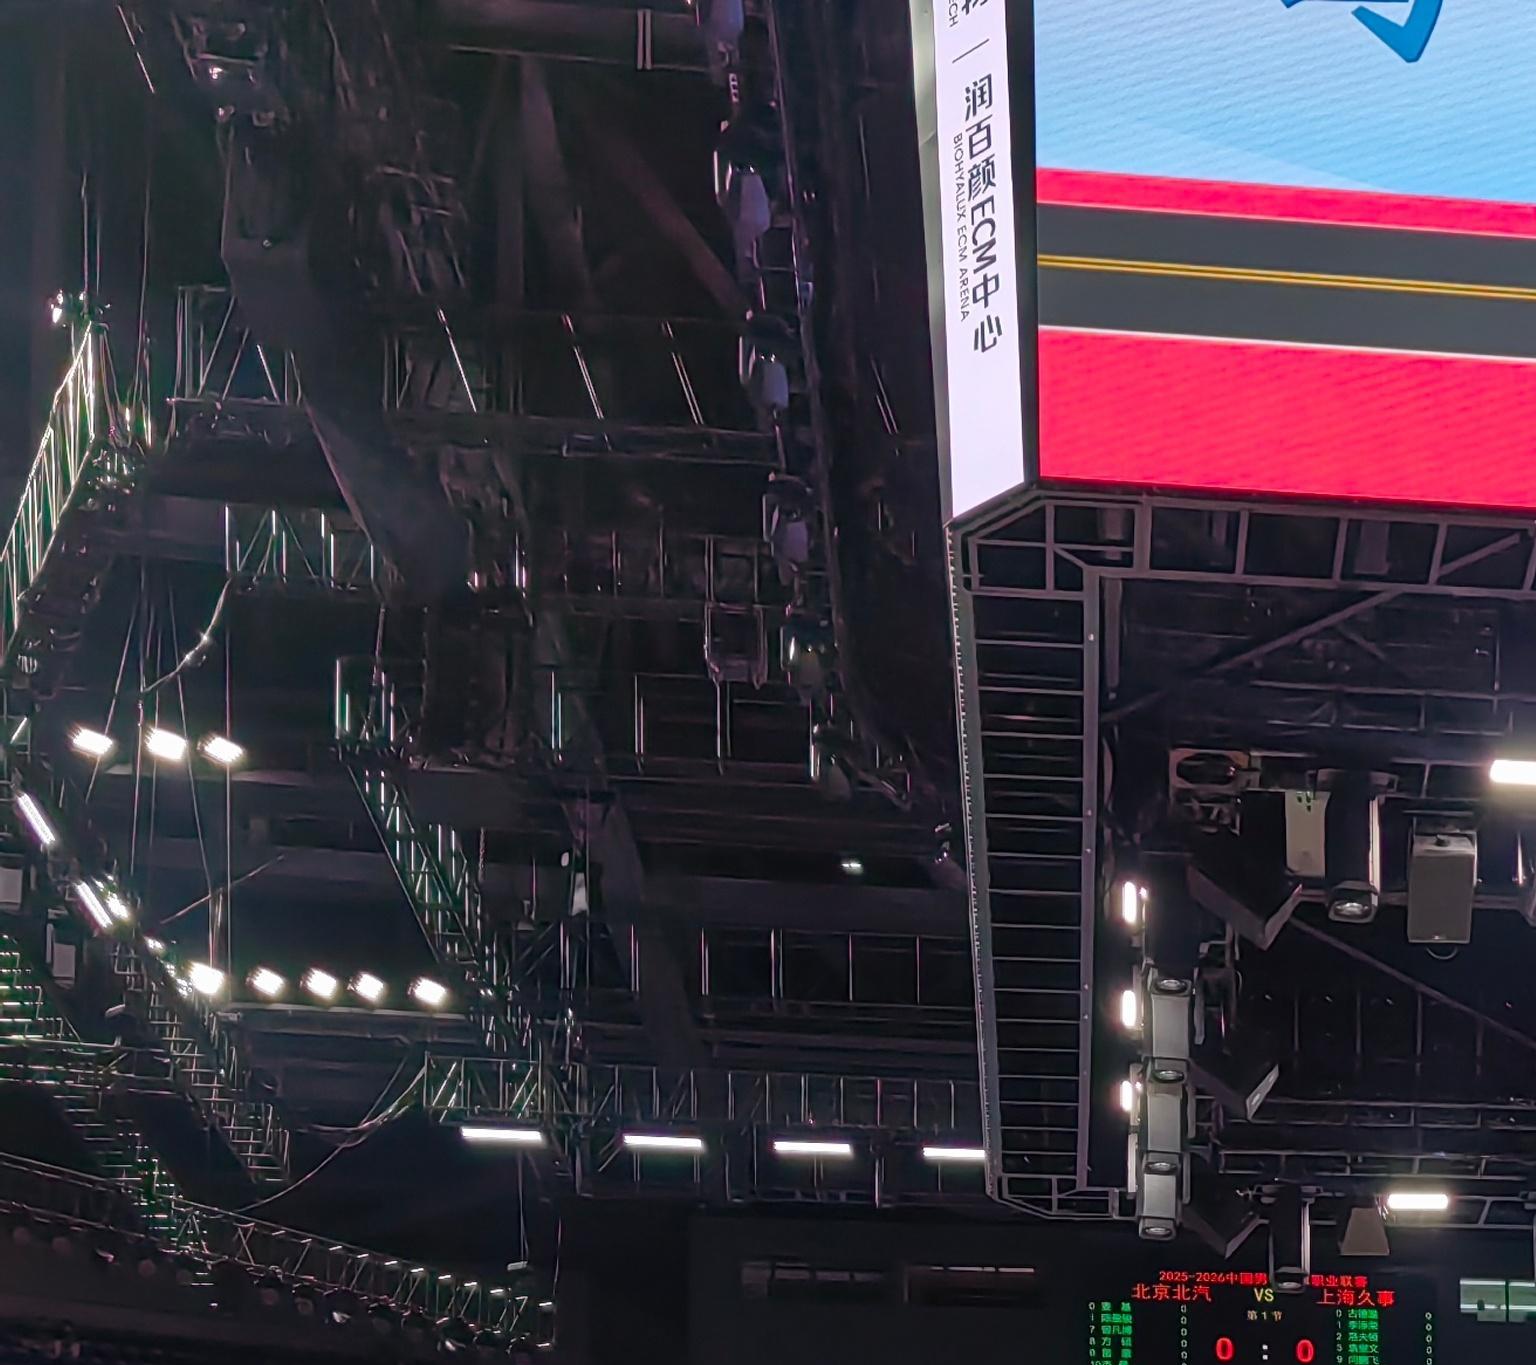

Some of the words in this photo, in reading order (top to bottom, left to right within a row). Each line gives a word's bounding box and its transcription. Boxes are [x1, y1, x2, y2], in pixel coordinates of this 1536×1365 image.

[965, 73, 1002, 353] 润百颜ECM中心
[957, 225, 967, 262] ECM
[958, 267, 970, 322] ARENA
[1131, 1284, 1212, 1302] 北京北汽
[1254, 1288, 1274, 1302] VS
[1316, 1288, 1396, 1306] 上海久事
[1216, 1337, 1234, 1361] 0
[1296, 1339, 1314, 1363] 0
